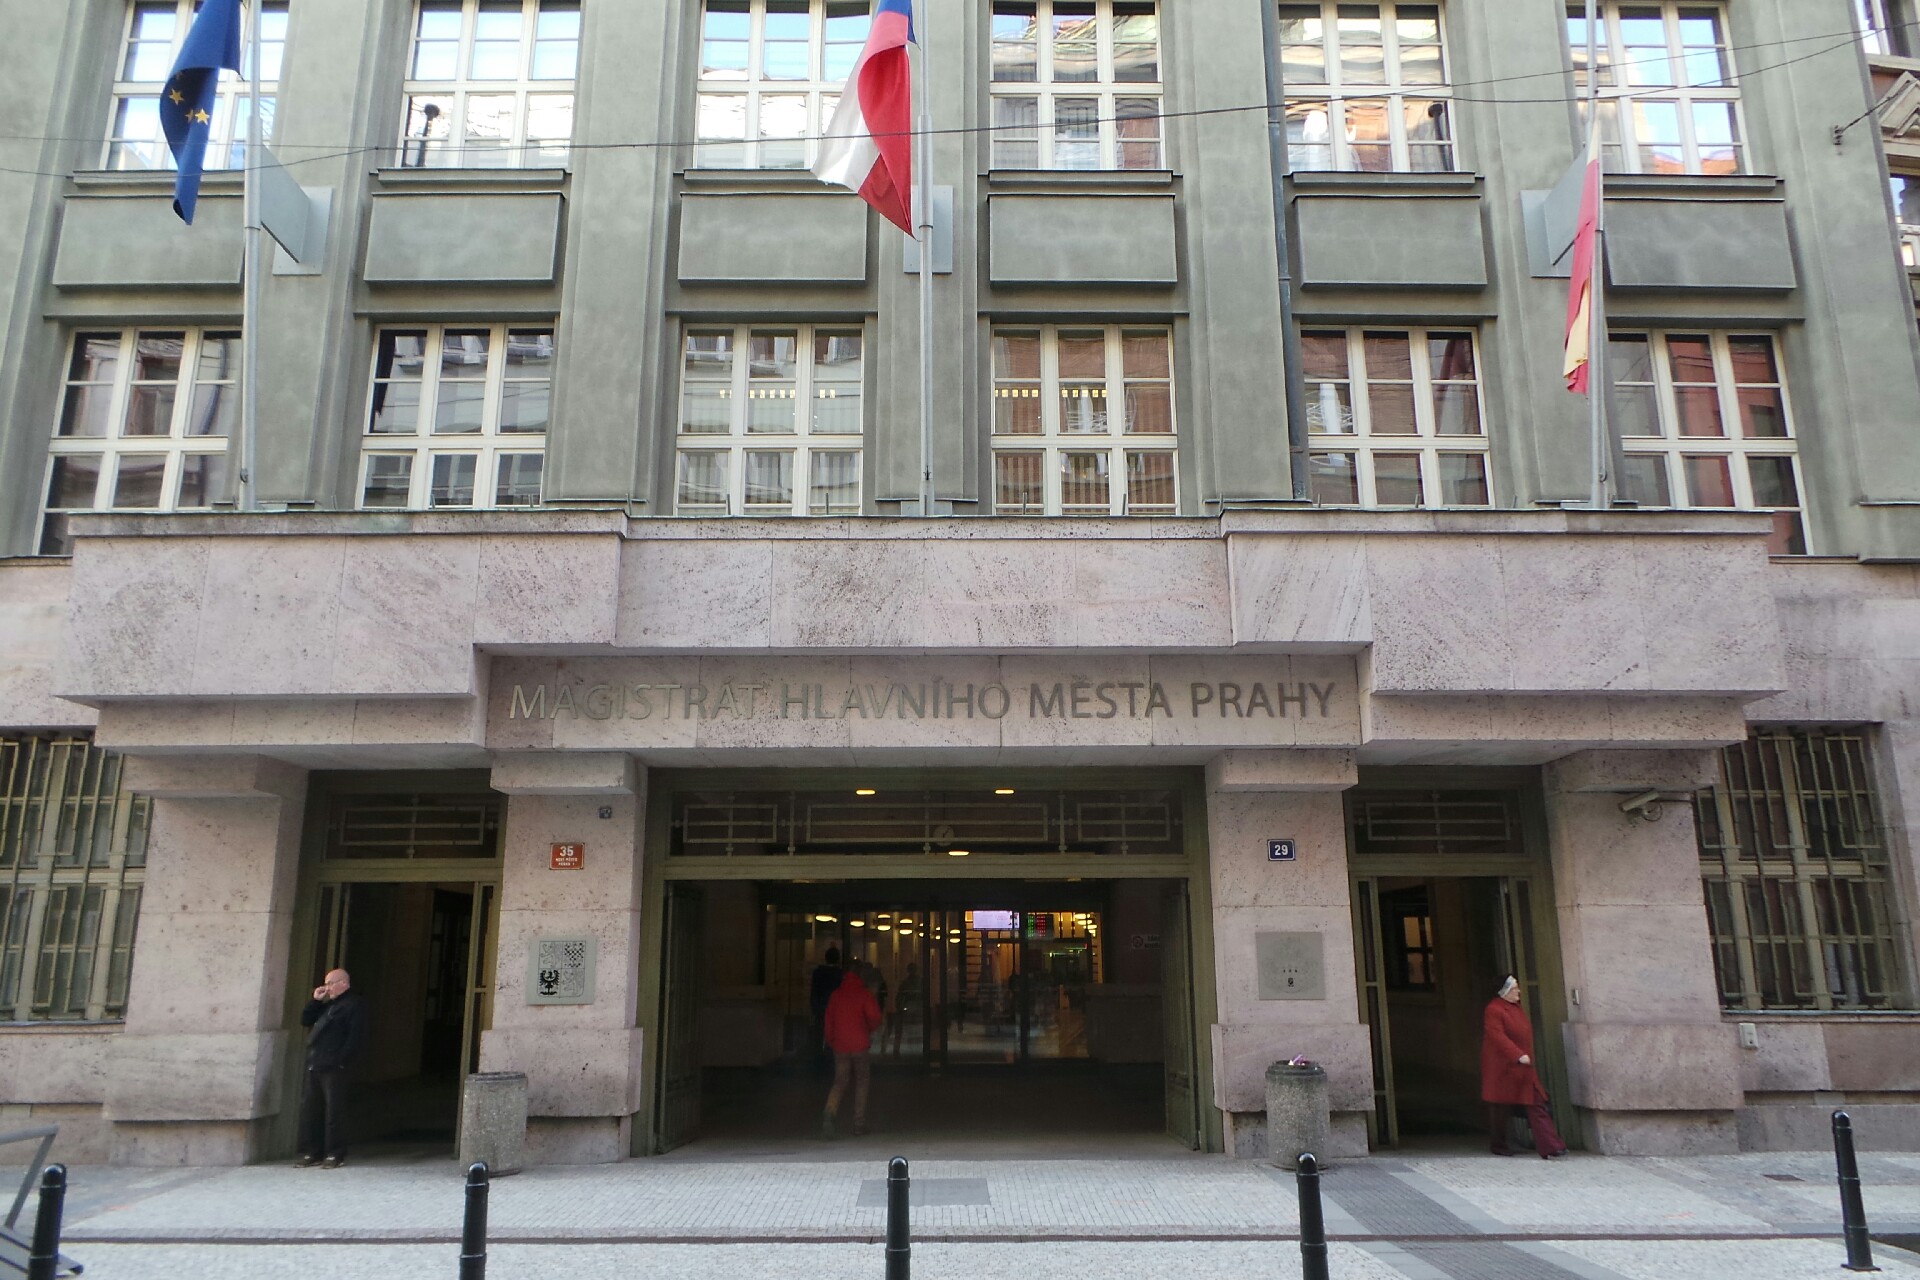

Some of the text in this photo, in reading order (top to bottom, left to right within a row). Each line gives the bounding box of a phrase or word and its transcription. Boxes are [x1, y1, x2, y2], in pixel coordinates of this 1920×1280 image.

[509, 674, 1336, 720] MAGISTRÁT HLAVNÍHO MĚSTA PRAHY
[559, 845, 574, 857] 35
[1274, 844, 1289, 856] 29
